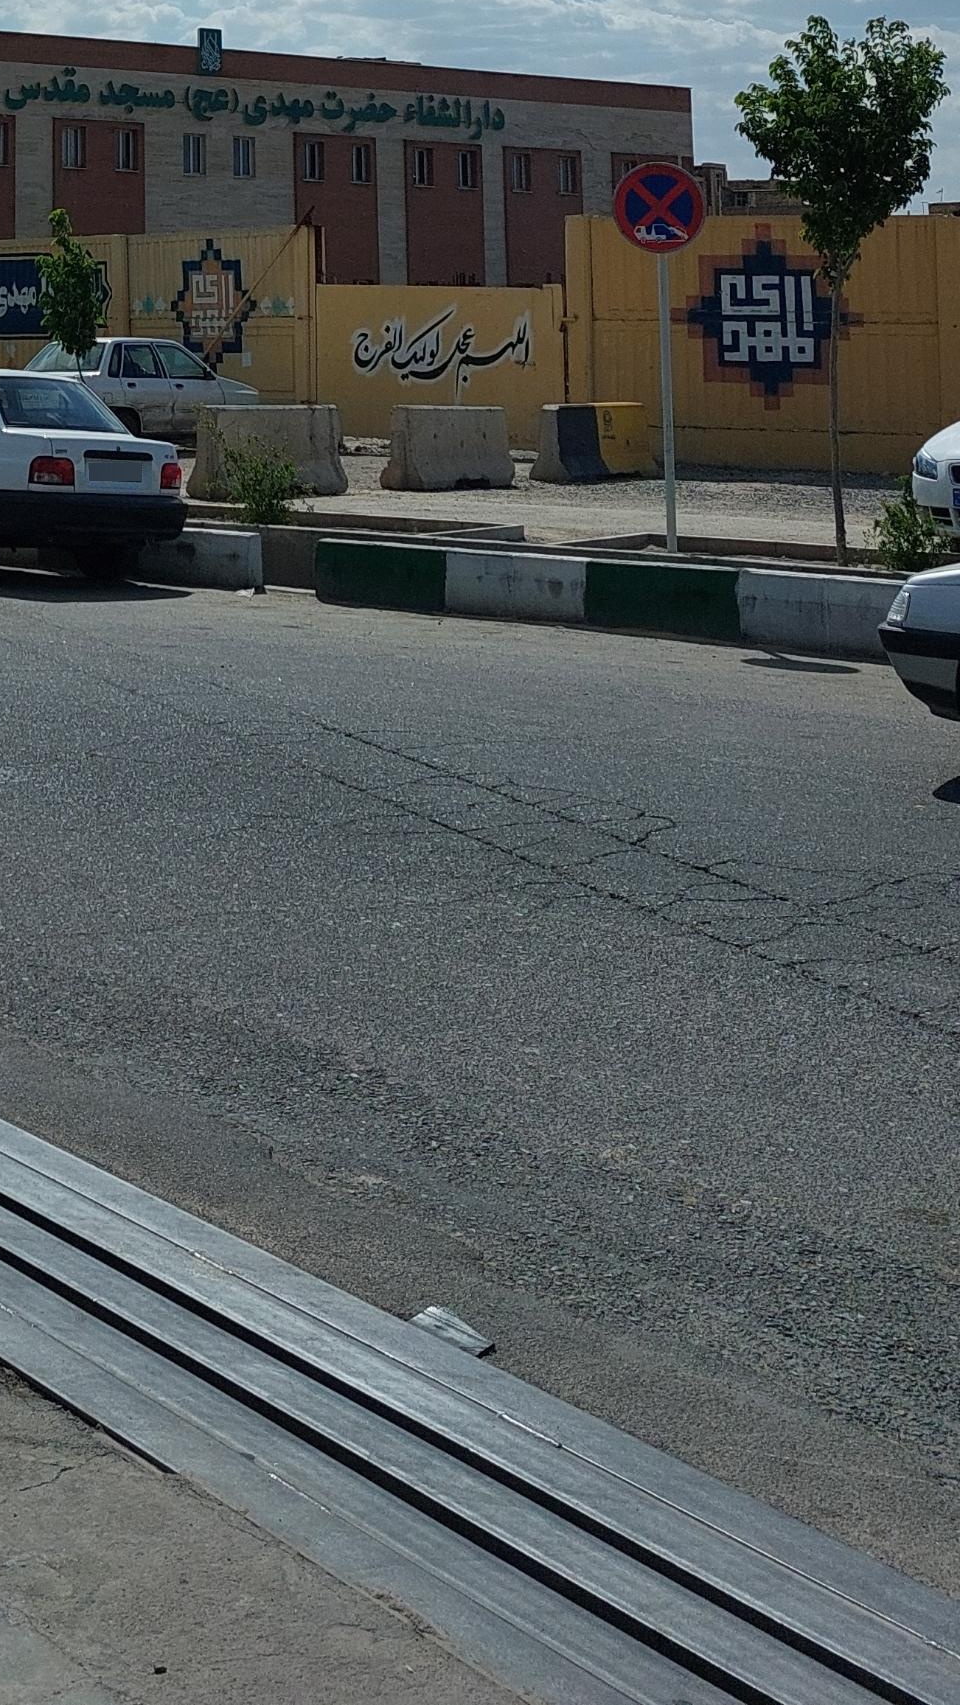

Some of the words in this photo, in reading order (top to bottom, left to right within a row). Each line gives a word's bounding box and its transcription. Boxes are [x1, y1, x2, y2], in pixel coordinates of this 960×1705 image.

[4, 66, 91, 111] مقدس
[99, 80, 176, 114] مسجد
[184, 85, 239, 122] (عج)
[244, 92, 315, 126] مهدی
[320, 89, 399, 134] حضرت
[353, 324, 403, 373] الفرج
[407, 327, 476, 383] عجل
[455, 320, 531, 398] اللهم
